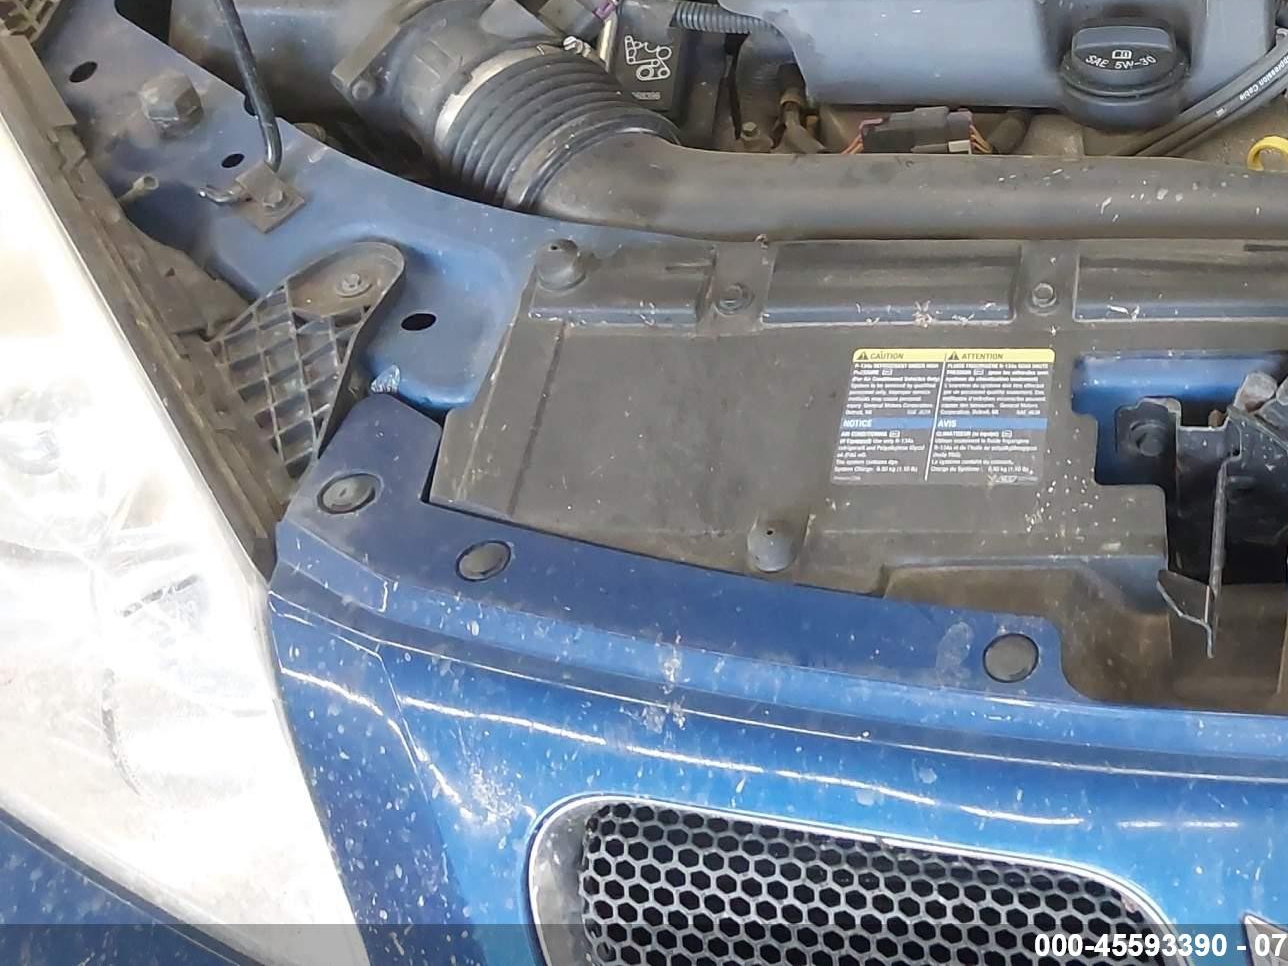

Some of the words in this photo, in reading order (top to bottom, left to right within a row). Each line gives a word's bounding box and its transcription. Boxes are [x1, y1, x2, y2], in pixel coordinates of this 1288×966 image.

[1085, 54, 1110, 68] SAE
[1114, 55, 1158, 69] 5W-30
[1239, 84, 1259, 101] Cable
[843, 419, 873, 428] NOTICE
[937, 419, 957, 428] AVIS
